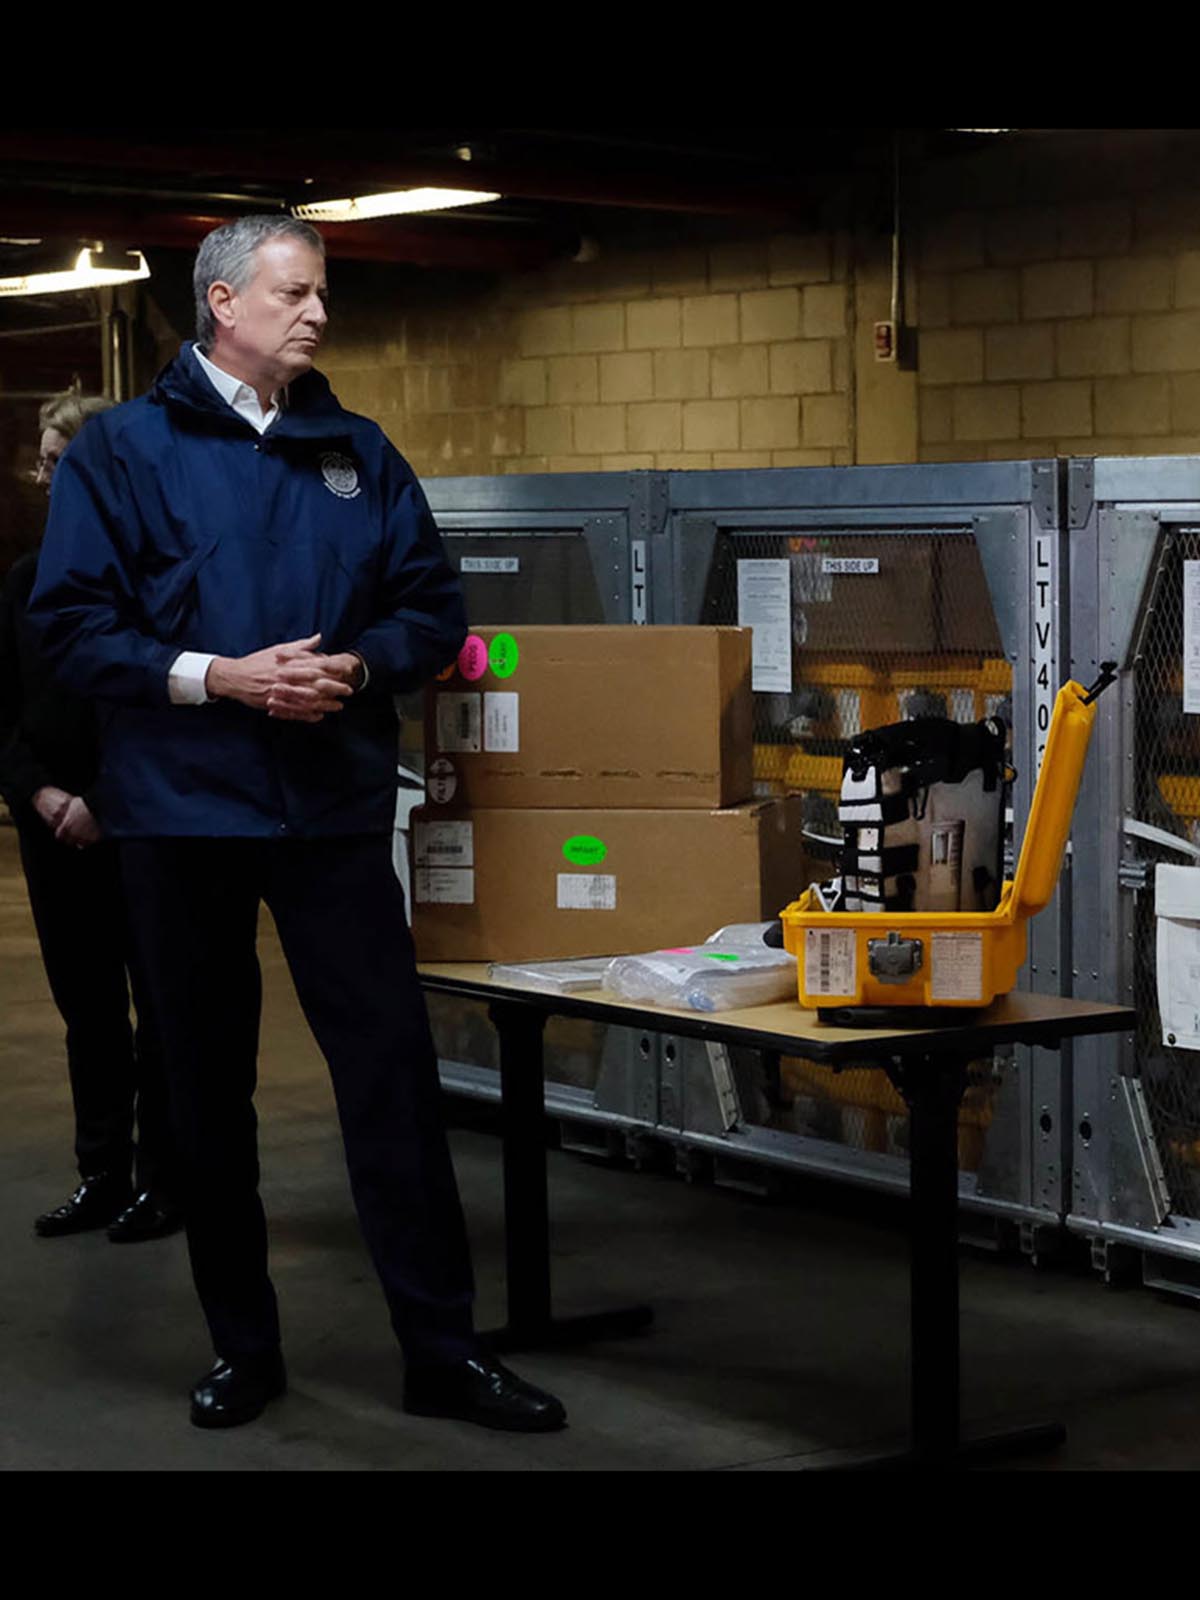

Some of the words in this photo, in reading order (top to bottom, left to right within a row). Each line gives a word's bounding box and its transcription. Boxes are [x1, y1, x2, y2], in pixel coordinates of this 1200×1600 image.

[634, 549, 646, 625] LT
[825, 560, 843, 571] THIS
[844, 560, 861, 571] SIDE
[863, 560, 875, 571] UP
